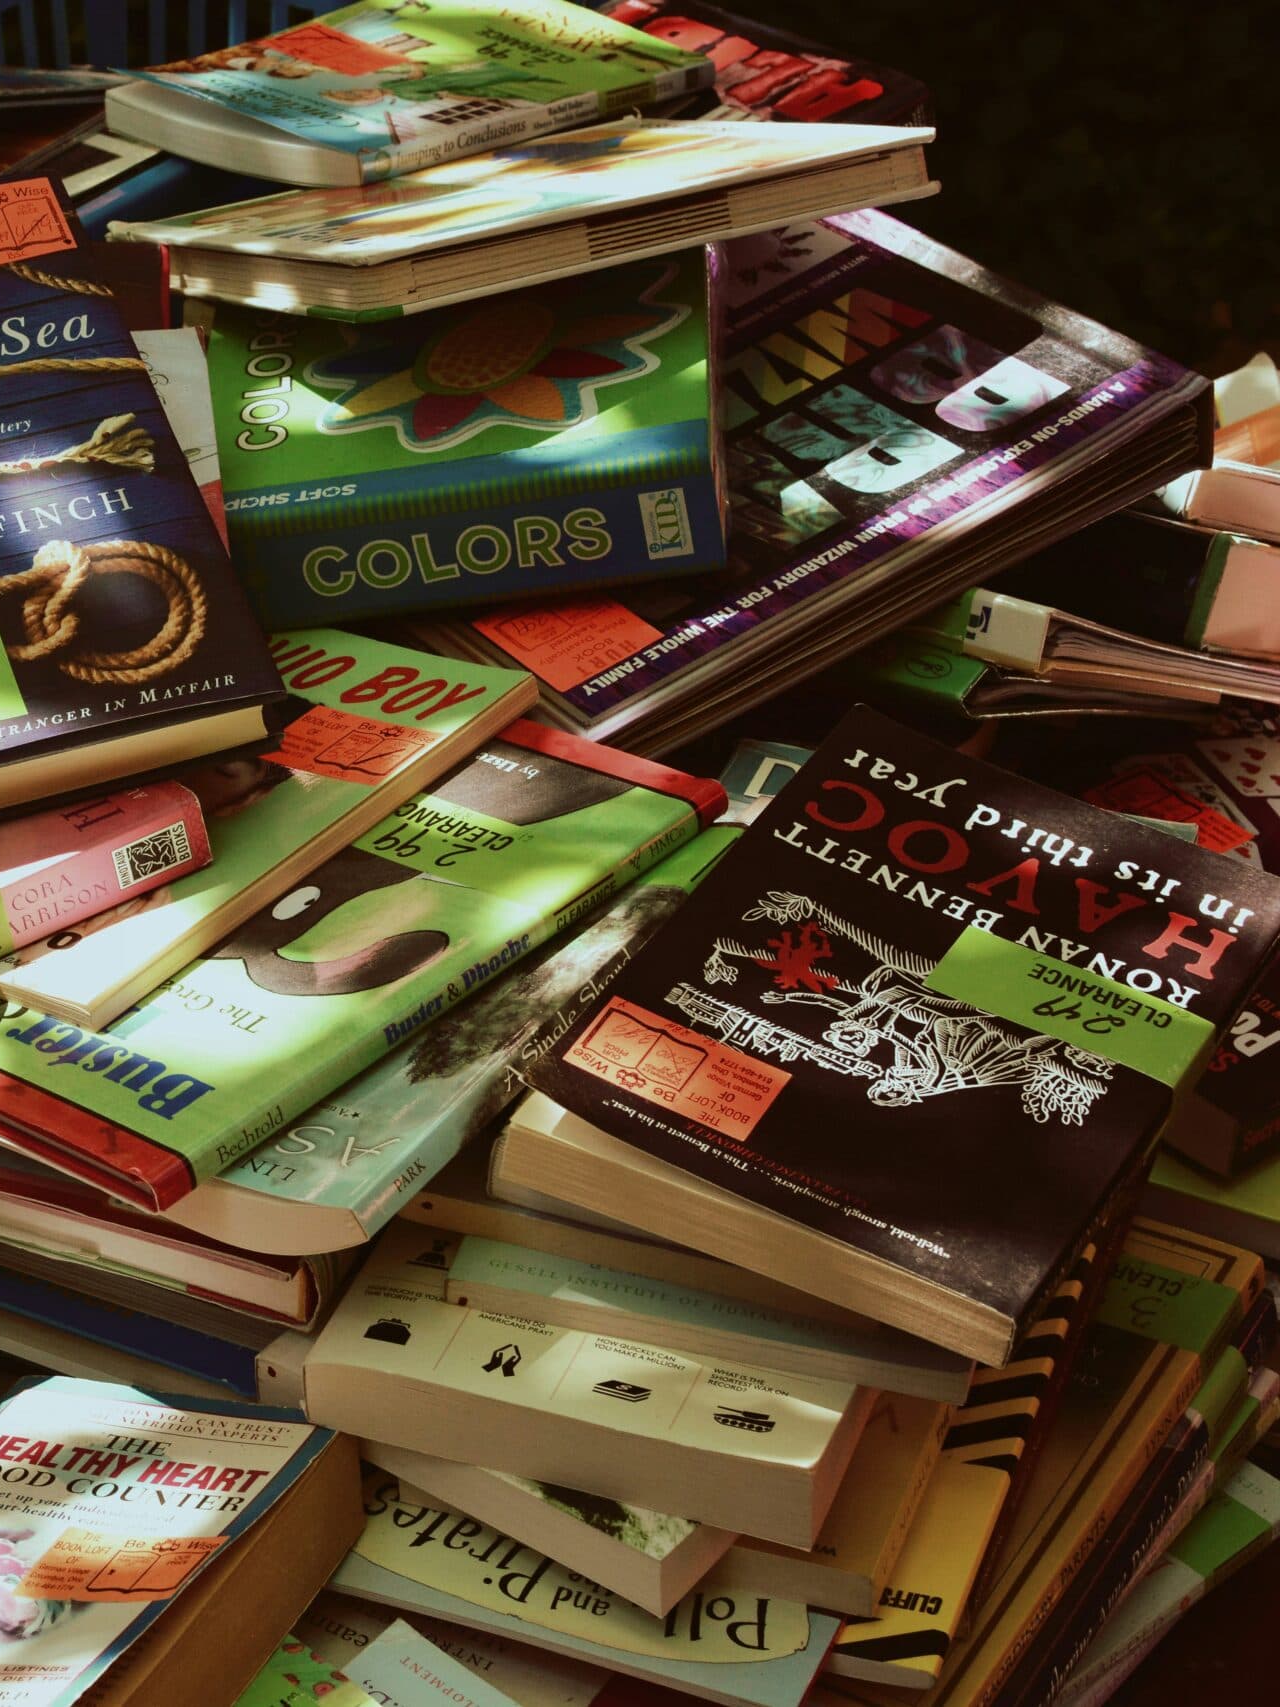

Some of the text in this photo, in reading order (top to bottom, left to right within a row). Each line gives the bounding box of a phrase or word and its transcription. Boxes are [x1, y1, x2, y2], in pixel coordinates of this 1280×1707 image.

[456, 119, 527, 150] Conclusions
[12, 185, 50, 198] Wise
[0, 311, 96, 357] Sea
[294, 483, 358, 504] SOFT
[302, 507, 613, 597] COLORS
[581, 389, 1112, 696] HANDS-ON BRAIN WIZARDRY FOR THE WHOLE FAMILY
[572, 637, 614, 662] BOOK
[576, 639, 637, 677] HURT
[138, 672, 238, 706] MAYFAIR
[340, 667, 487, 721] BOY
[519, 764, 541, 780] by
[394, 797, 517, 850] CLEARANC
[171, 824, 191, 862] BOOKS
[372, 822, 458, 868] 2.99
[843, 747, 1257, 935] in its third year
[115, 850, 129, 888] MINOTAUR
[803, 779, 1240, 981] HAVOC
[10, 873, 74, 912] CORA
[554, 877, 618, 932] CLEARANCE
[774, 820, 1202, 1010] RONAN BENNETT
[1028, 965, 1176, 1031] CLEARANCE
[219, 1001, 270, 1034] The
[214, 930, 533, 1167] Bechtold Buster & Phoebe
[6, 1018, 217, 1121] Buster
[572, 1047, 677, 1103] Be Wise
[686, 1091, 752, 1125] BOOK LOFT
[717, 1090, 736, 1104] OF
[729, 1084, 762, 1101] German
[636, 1113, 655, 1128] his
[655, 1122, 667, 1132] at
[698, 1110, 721, 1128] THE
[340, 1135, 401, 1168] A
[667, 1125, 713, 1151] Bennett
[712, 1147, 723, 1158] is
[391, 1156, 428, 1194] PARK
[723, 1154, 749, 1173] This
[841, 1205, 888, 1230] strongly
[566, 1272, 671, 1301] INSTITUTE
[677, 1296, 701, 1308] OF
[478, 1313, 554, 1339] AMERICANS PRAY?
[597, 1338, 677, 1363] HOW QUICKLY CAN
[614, 1347, 638, 1359] MAKE
[647, 1356, 686, 1372] MILLION?
[707, 1379, 748, 1393] RECORD?
[710, 1374, 754, 1391] SHORTEST
[713, 1368, 736, 1380] WHAT
[190, 1418, 228, 1433] CAN
[198, 1428, 281, 1443] EXPERTS
[105, 1433, 172, 1457] THE
[136, 1459, 270, 1494] HEART
[18, 1494, 36, 1506] up
[37, 1496, 70, 1510] your
[66, 1477, 246, 1512] COUNTER
[53, 1540, 85, 1553] BOOK
[124, 1537, 222, 1551] Be Wise
[64, 1555, 81, 1566] OF
[553, 1586, 611, 1619] and
[4, 1662, 72, 1674] LISTINGS
